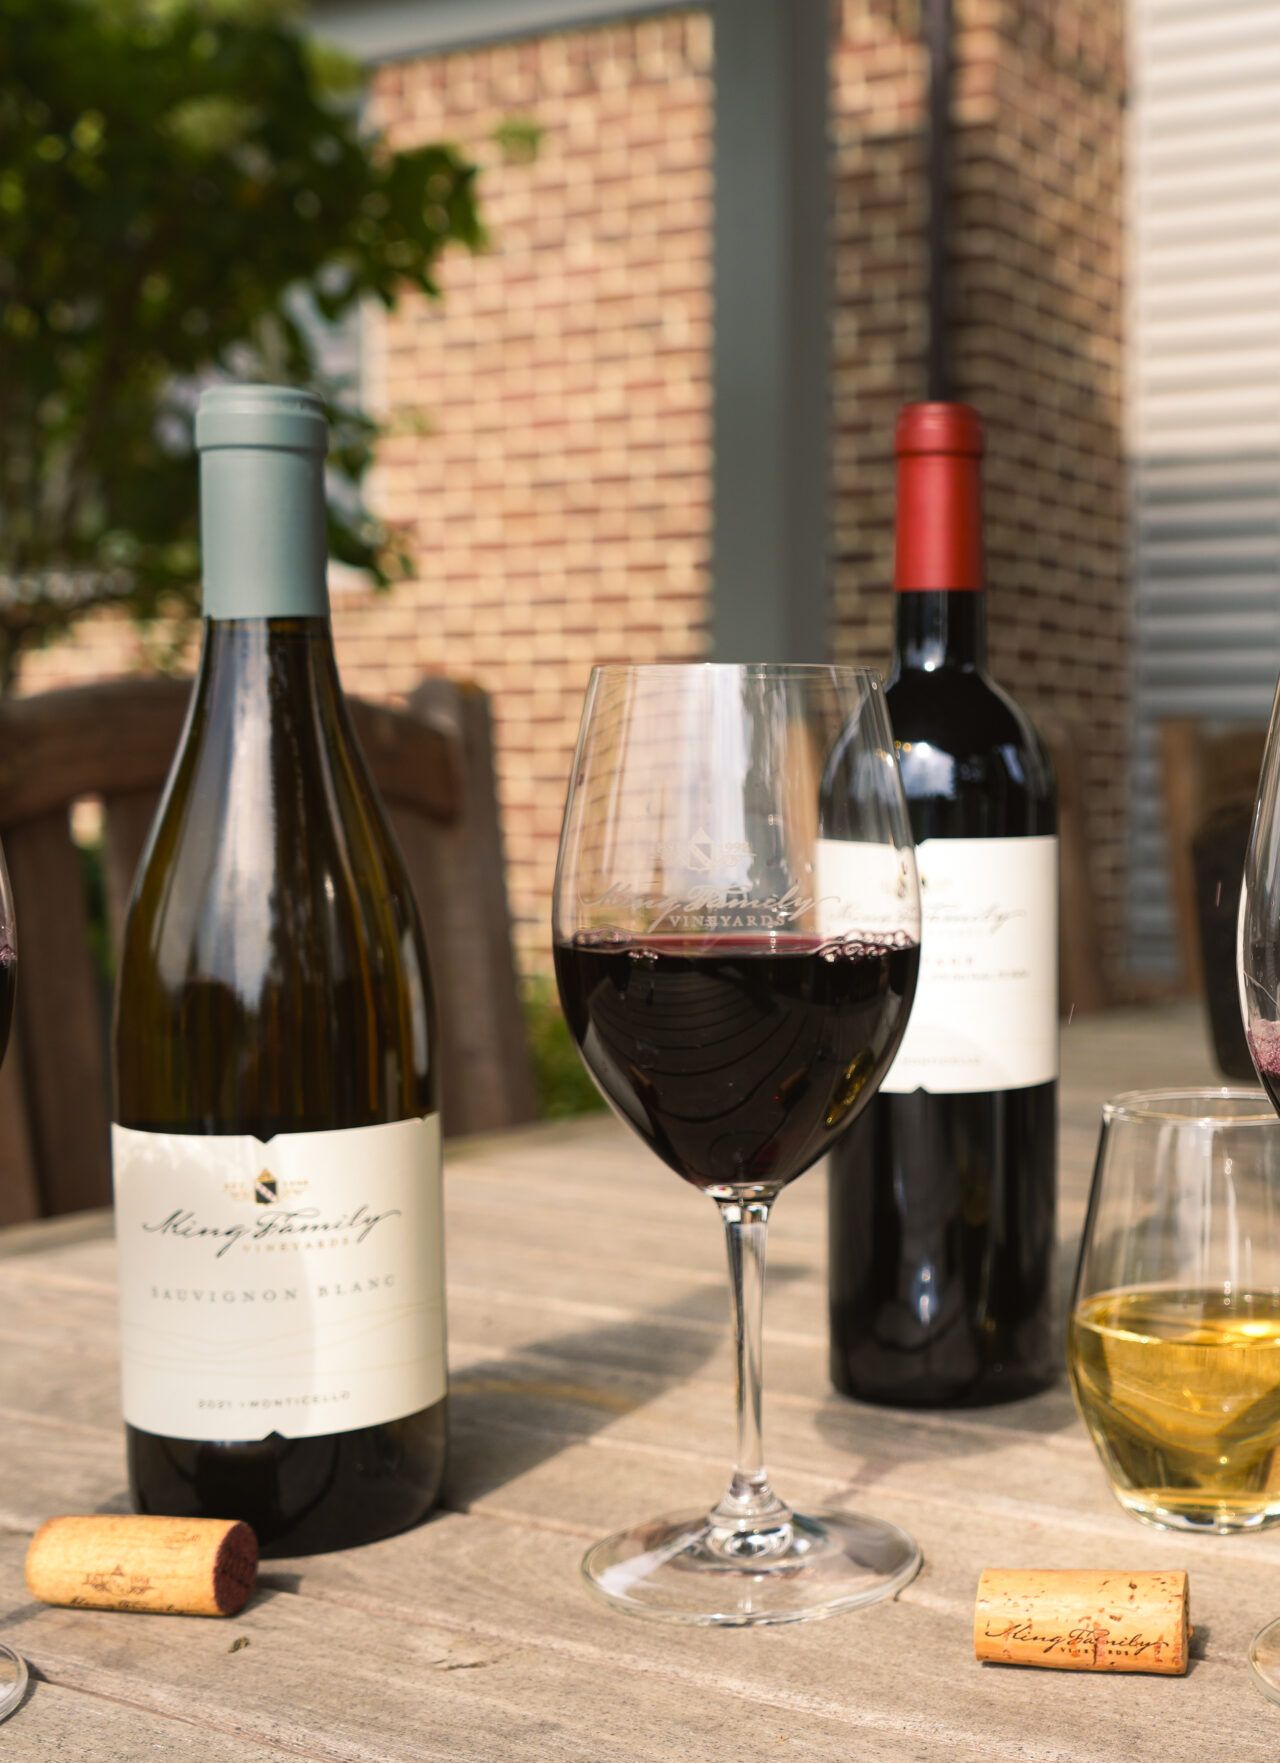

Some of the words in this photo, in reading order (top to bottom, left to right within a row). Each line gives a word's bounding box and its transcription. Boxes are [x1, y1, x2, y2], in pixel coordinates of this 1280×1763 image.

[669, 915, 787, 928] VINEYARDS
[253, 1204, 401, 1244] Family
[152, 1285, 298, 1303] SAUVIGNON
[317, 1274, 395, 1298] BLANC
